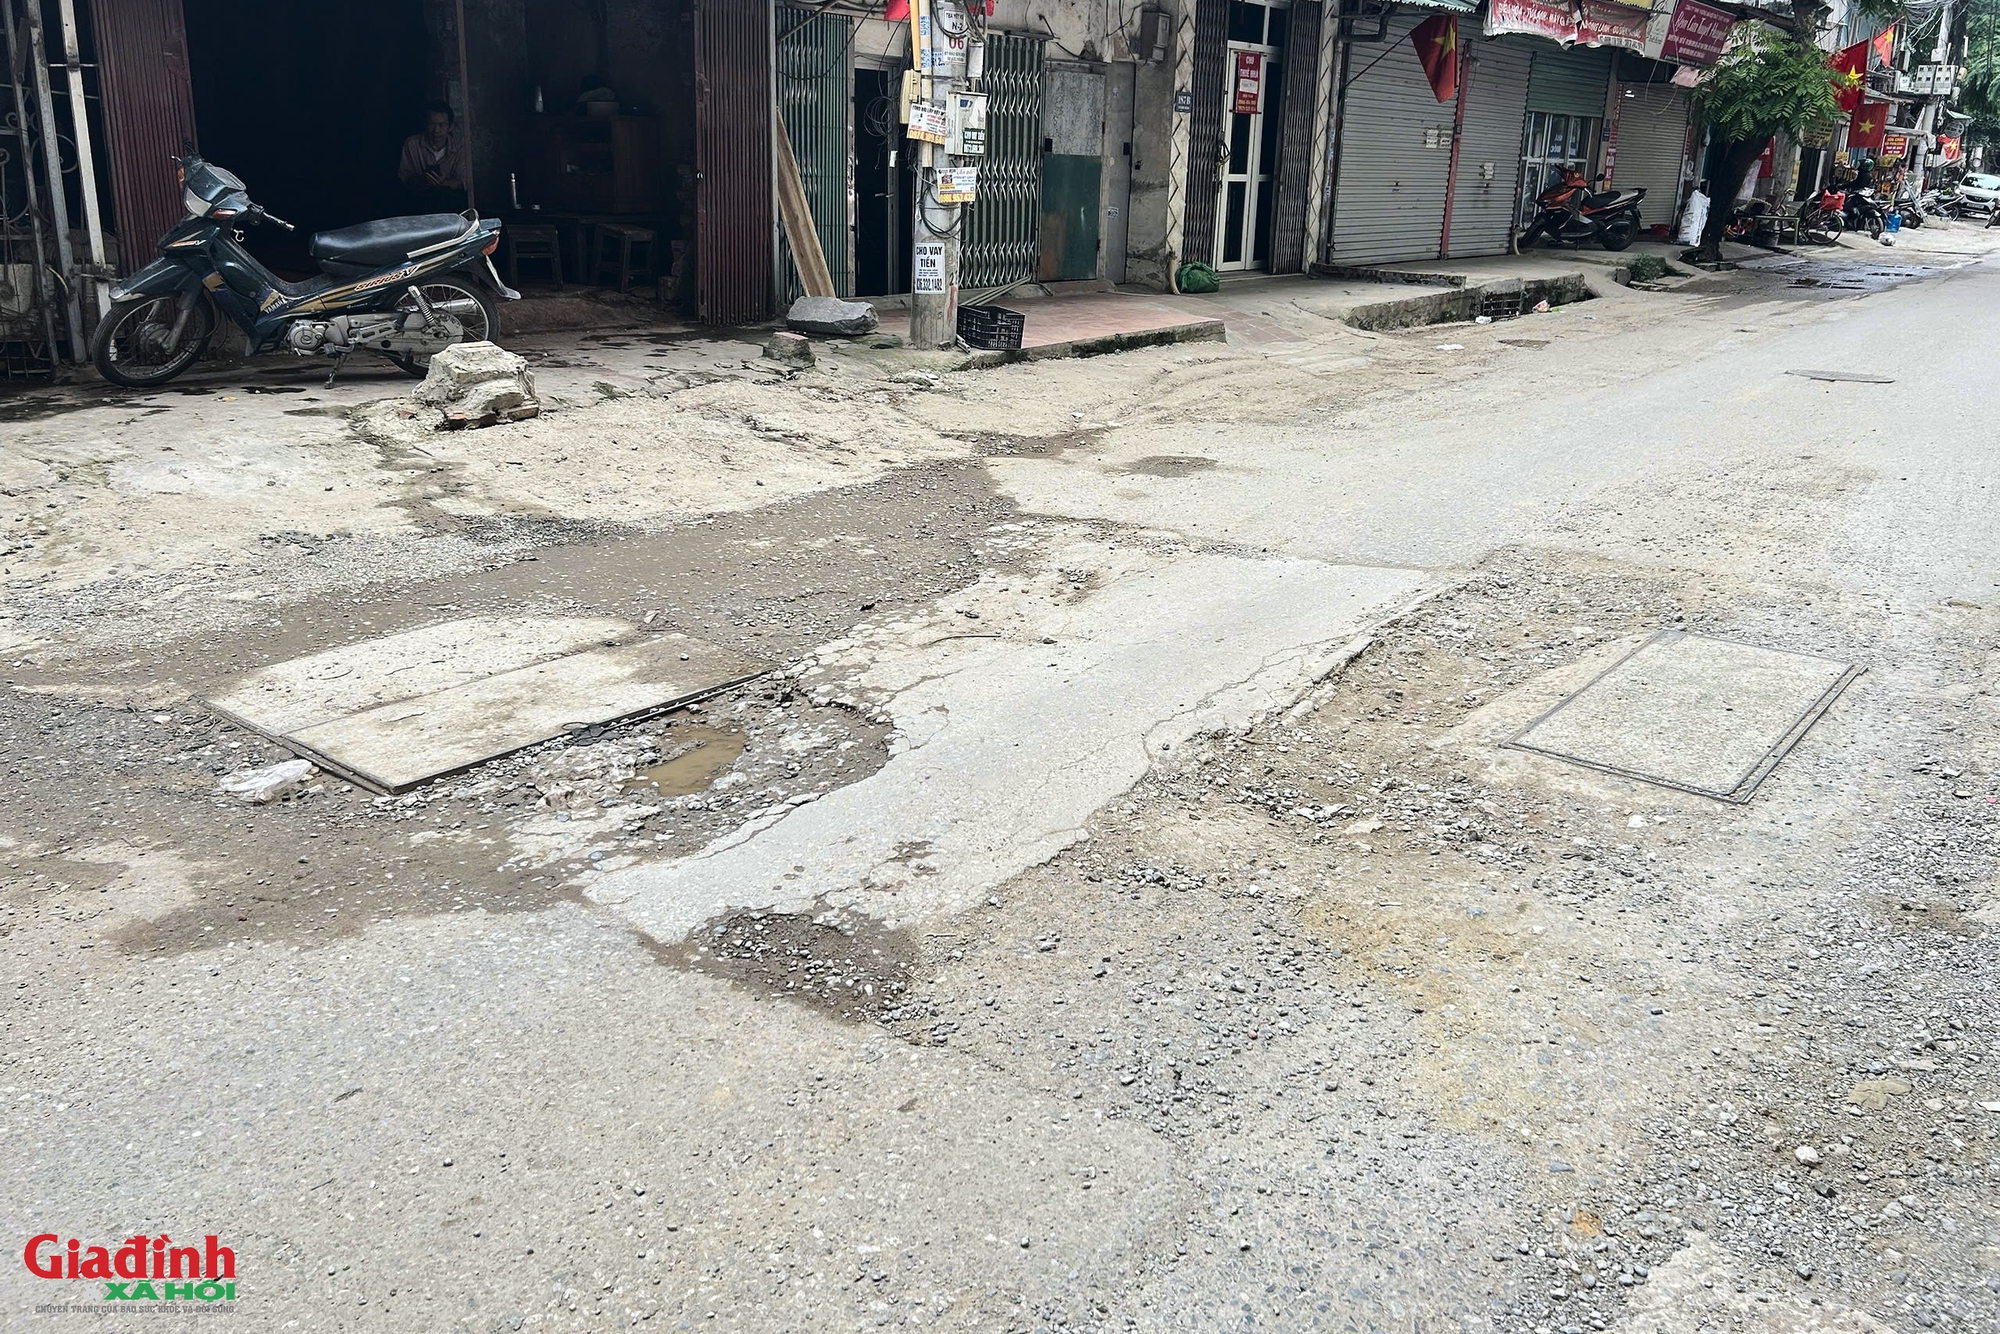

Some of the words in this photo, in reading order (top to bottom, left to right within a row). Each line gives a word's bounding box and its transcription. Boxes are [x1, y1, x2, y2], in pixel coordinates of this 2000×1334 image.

[916, 246, 928, 256] CHO
[929, 246, 943, 256] VAY
[920, 255, 936, 268] TIỀN
